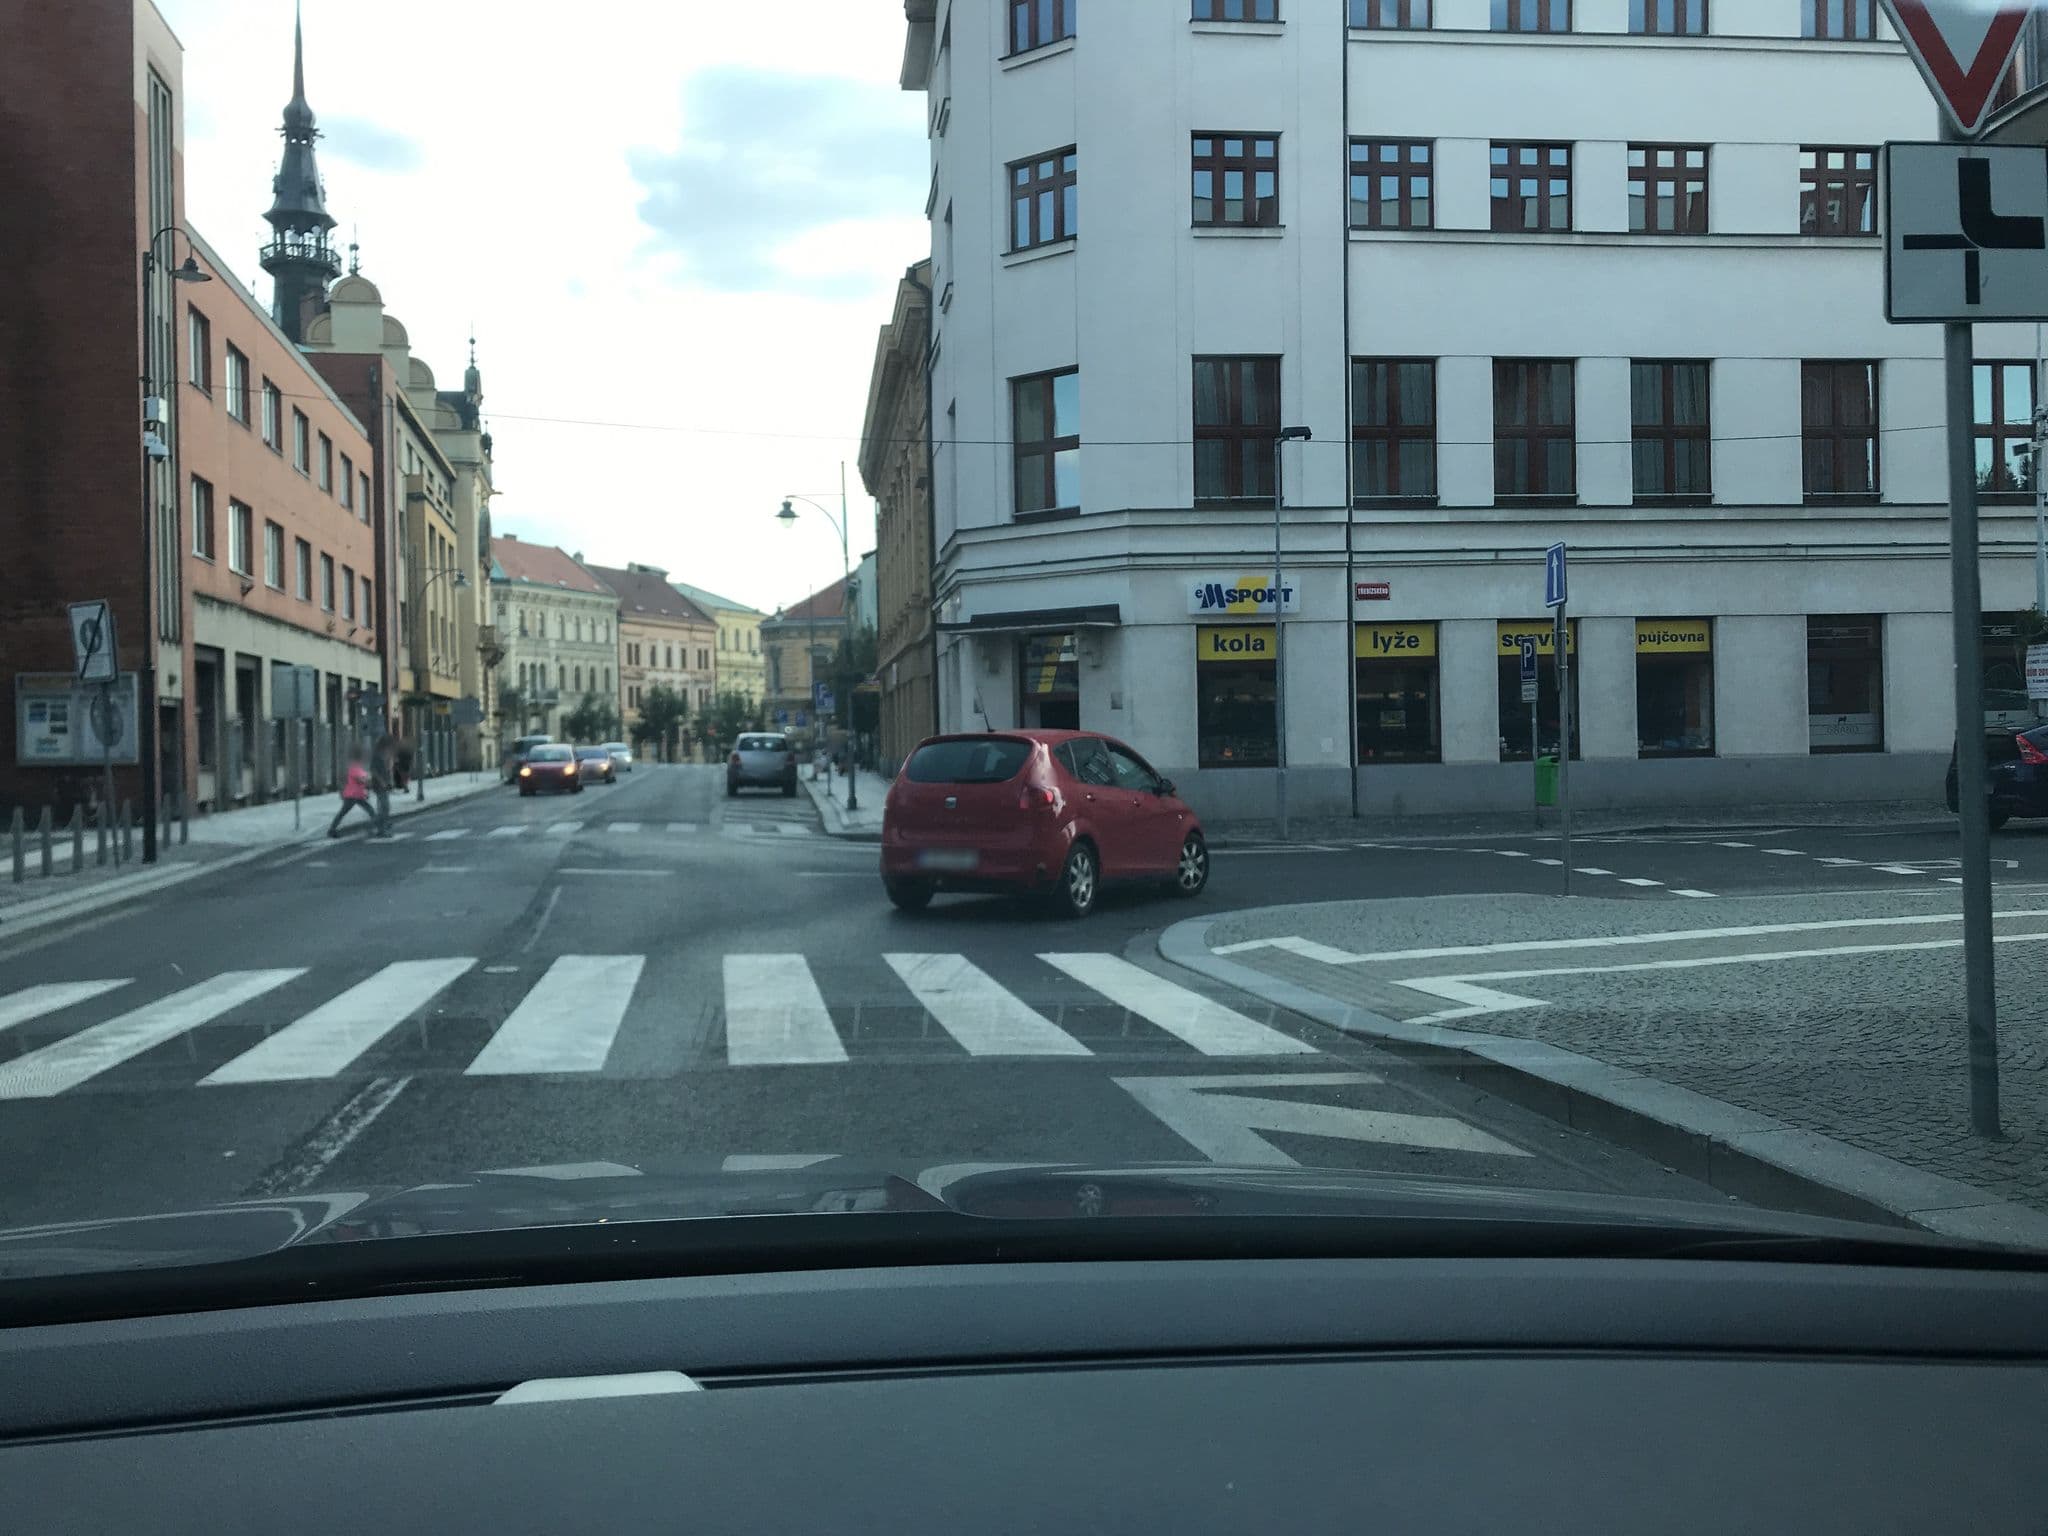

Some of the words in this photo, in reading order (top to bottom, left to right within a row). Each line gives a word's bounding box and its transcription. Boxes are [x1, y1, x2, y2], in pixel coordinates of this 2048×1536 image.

[1213, 633, 1265, 652] kola
[1373, 631, 1419, 653] lyže
[1502, 628, 1570, 647] sevi
[1523, 643, 1533, 668] P
